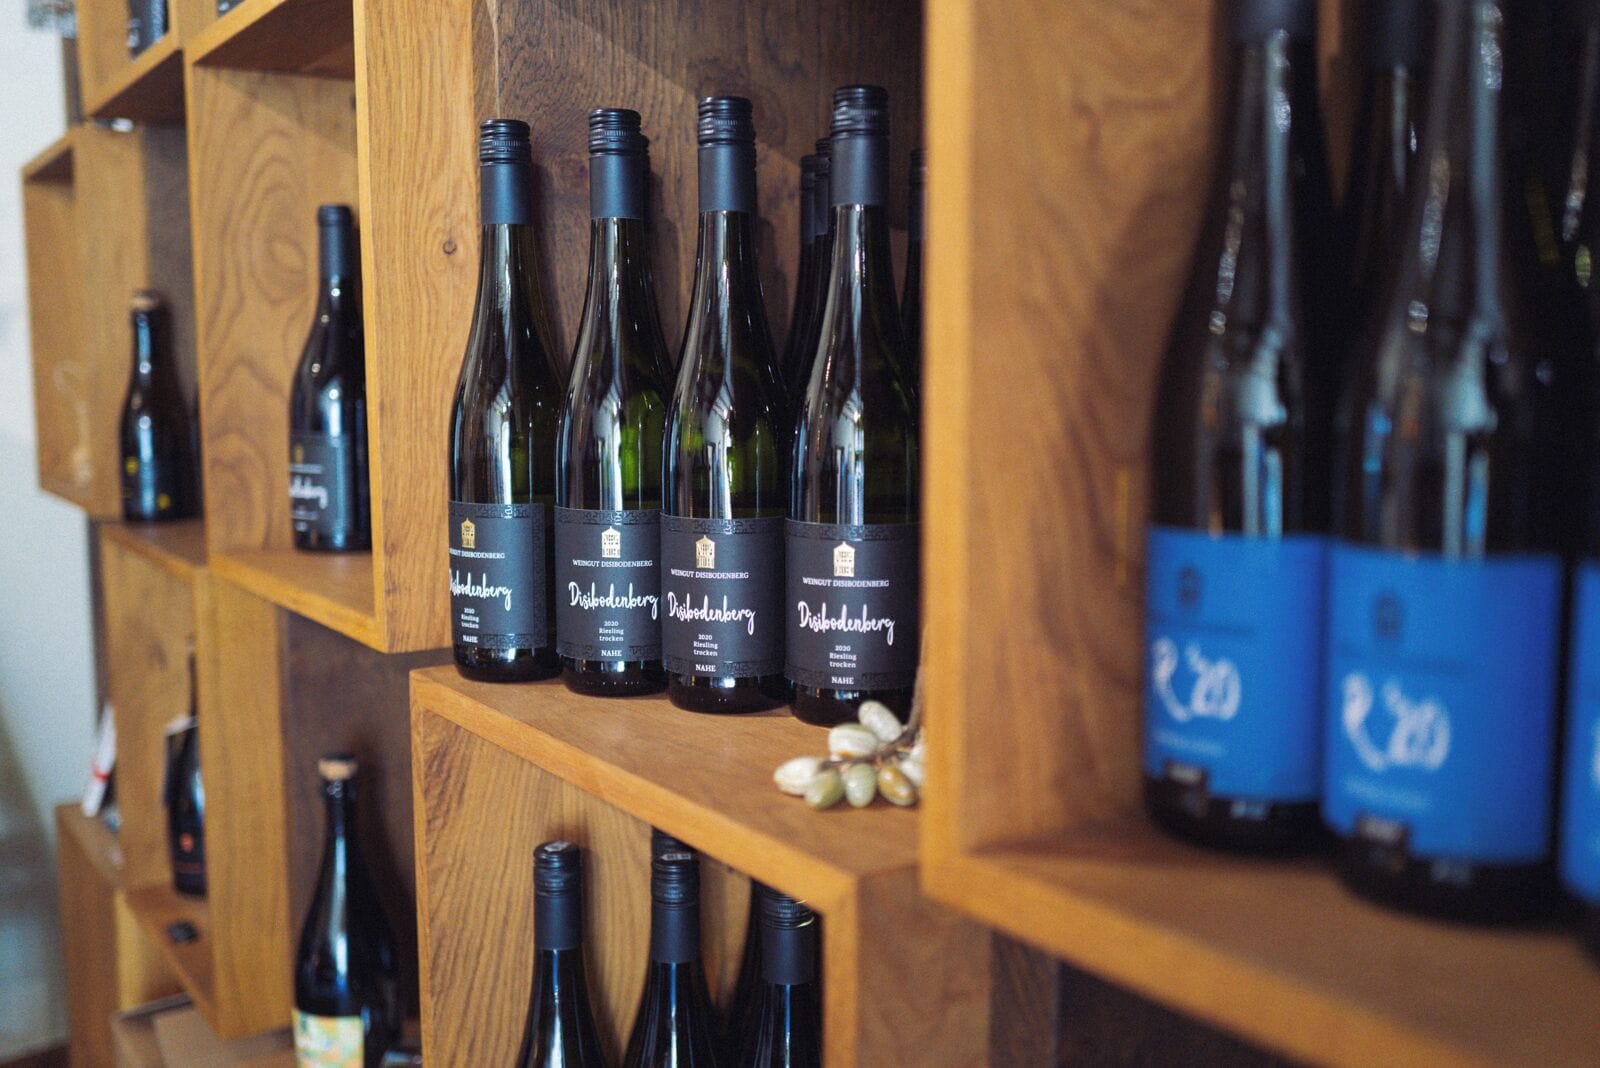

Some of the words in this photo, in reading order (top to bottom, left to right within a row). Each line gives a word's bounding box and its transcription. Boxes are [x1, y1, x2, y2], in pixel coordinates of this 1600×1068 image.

[572, 559, 600, 567] WEINGUT
[601, 559, 653, 568] DISIBODENBERG
[670, 568, 694, 578] WEINGUT
[695, 571, 749, 579] DISIBODENBERG
[802, 577, 832, 586] WEINGUT
[832, 580, 889, 588] DISIBODENBERG
[568, 581, 659, 620] Disibodenberg
[667, 591, 756, 636] Disibodenberg
[461, 614, 479, 623] Riesling
[798, 600, 896, 646] Disibodenberg
[462, 634, 478, 643] NAHE
[693, 641, 718, 650] Riesling
[601, 649, 622, 657] NAHE
[829, 652, 856, 661] Riesling
[695, 664, 716, 672] NAHE
[831, 676, 854, 684] NAHE
